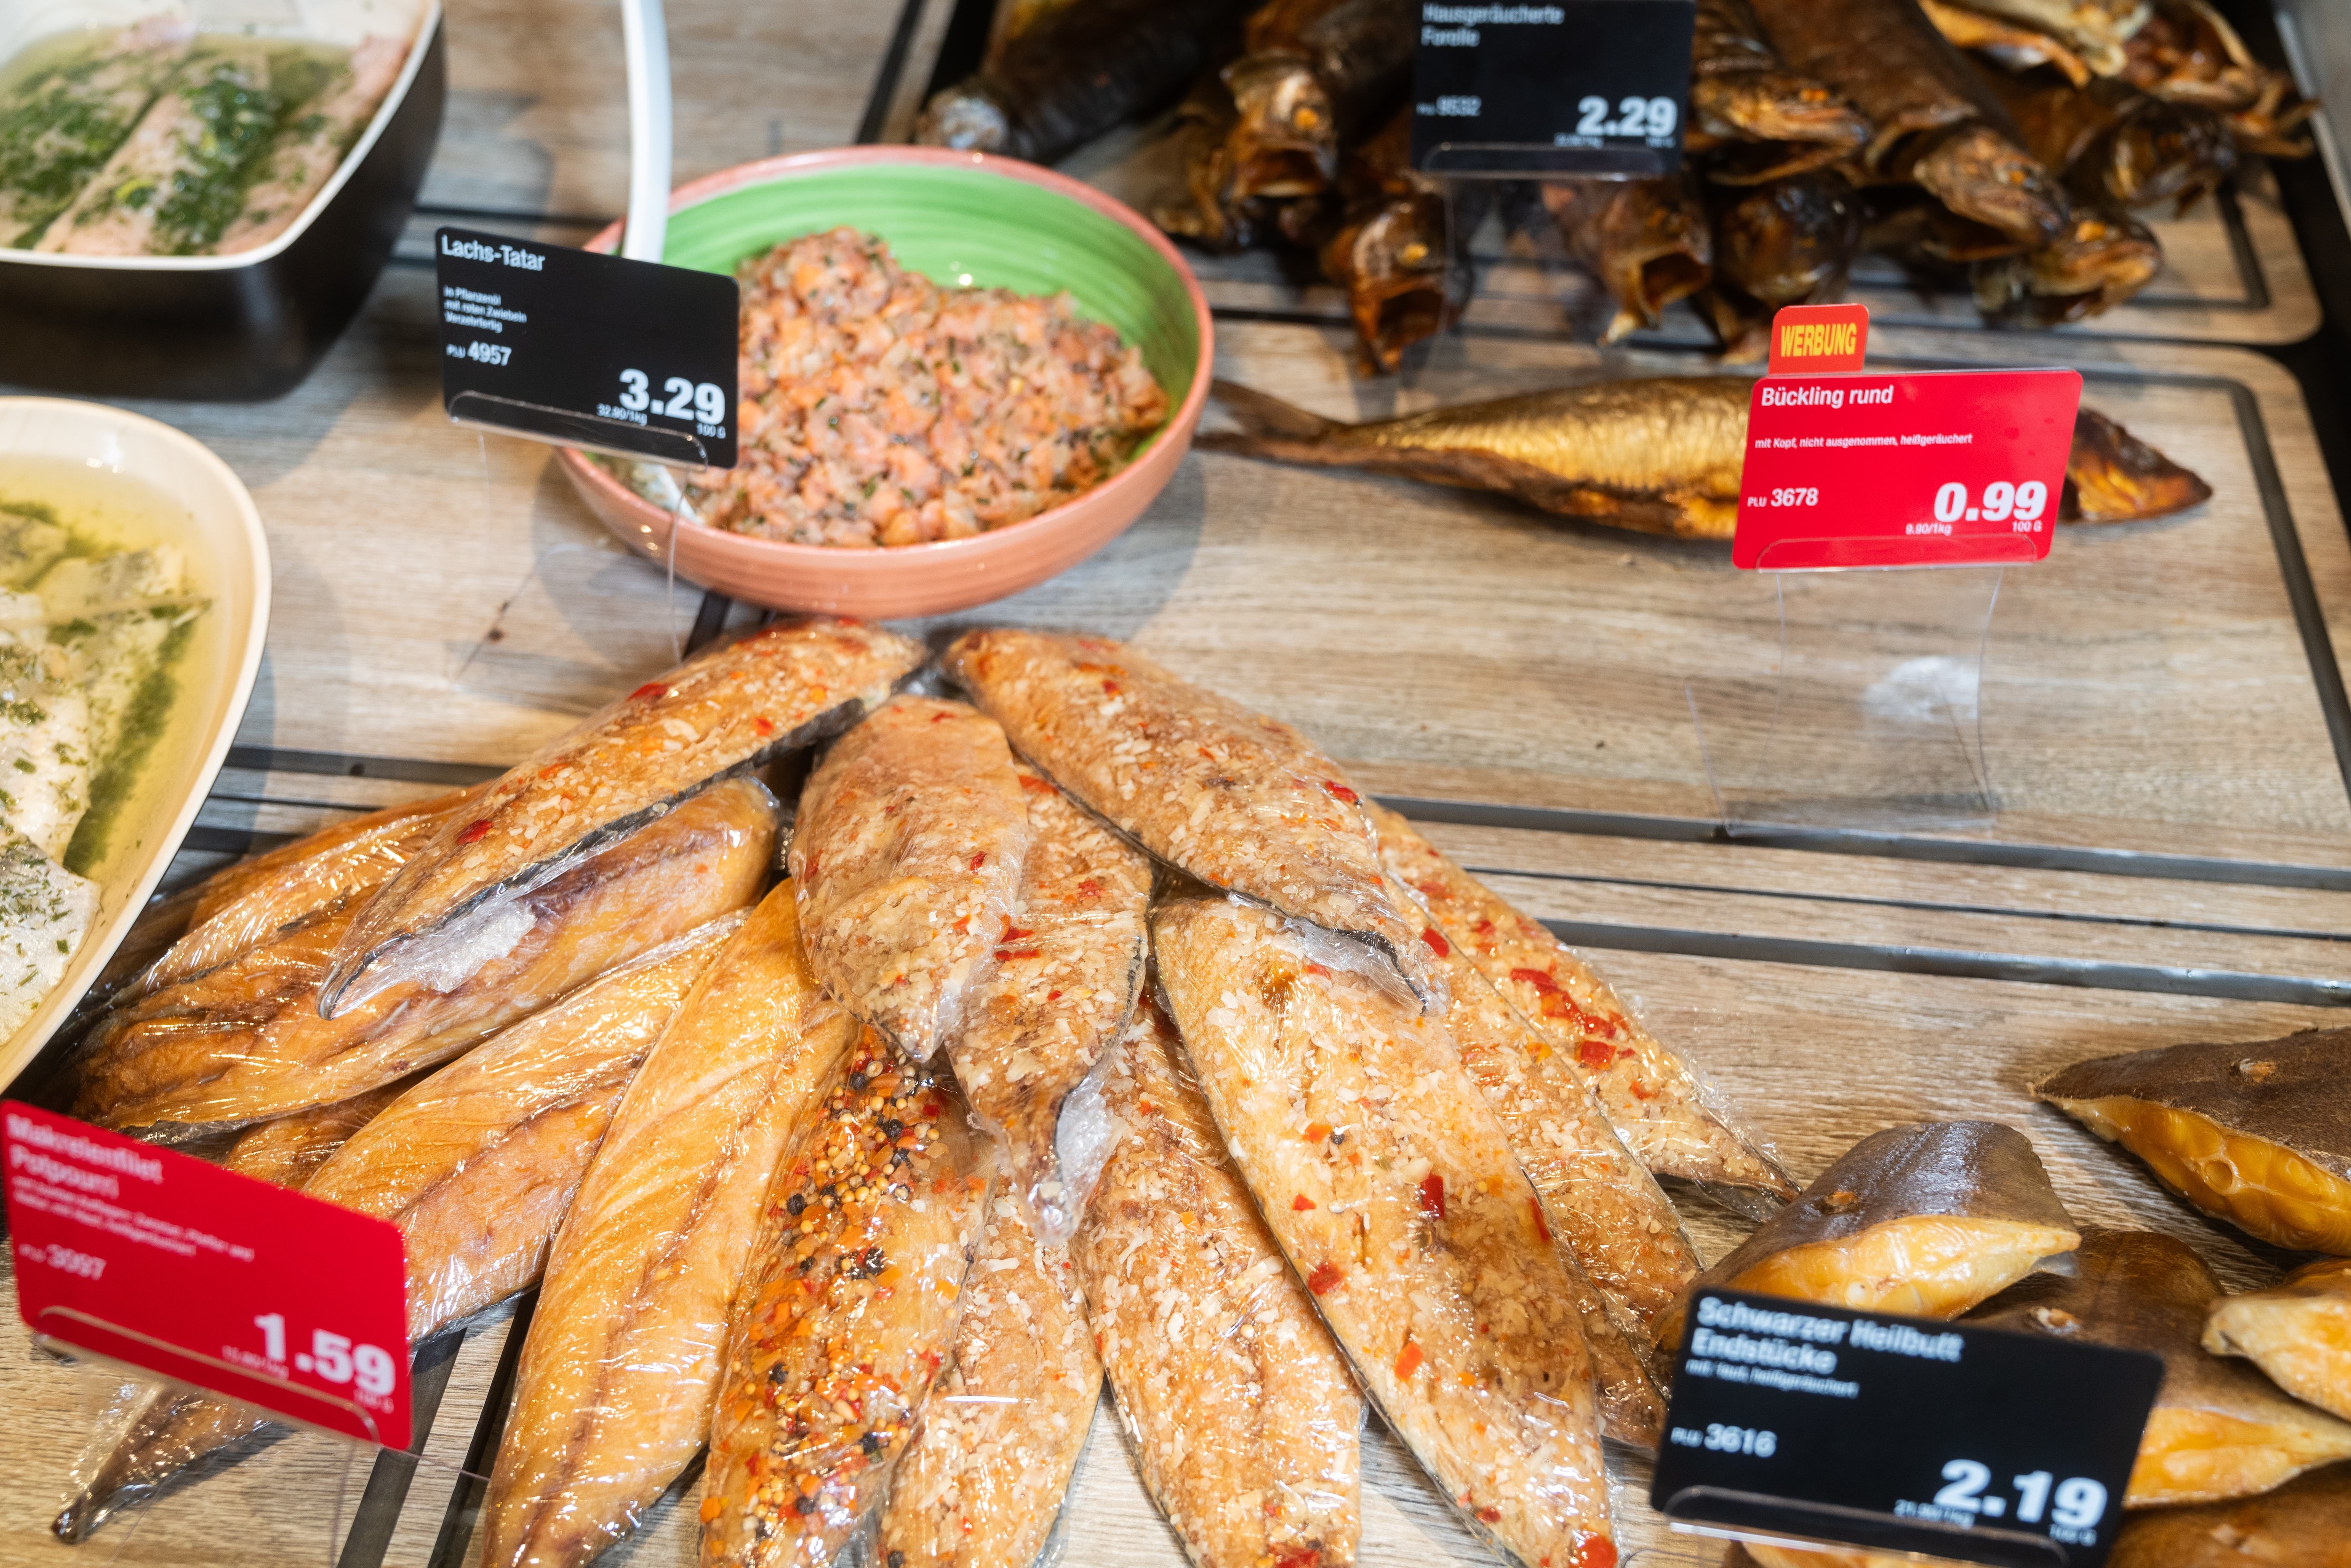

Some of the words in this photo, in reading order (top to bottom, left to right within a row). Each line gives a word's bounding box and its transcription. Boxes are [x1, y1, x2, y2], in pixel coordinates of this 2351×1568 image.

[1422, 2, 1565, 27] Hausgeräucherte
[1421, 24, 1480, 47] Forelle
[1576, 95, 1678, 136] 2.29
[442, 235, 545, 271] Lachs-Tatar
[454, 286, 501, 306] Pflanzenöl
[444, 299, 460, 311] mit
[461, 302, 485, 315] roten
[485, 305, 527, 323] Zwiebeln
[444, 310, 503, 333] Verzehrfertig
[1781, 323, 1857, 357] WERBUNG
[446, 344, 465, 358] PLU
[467, 340, 512, 366] 4957
[619, 368, 725, 425] 3.29
[1761, 387, 1844, 409] Bückling
[1849, 385, 1893, 404] rund
[597, 403, 647, 426] 32.90/1kg
[696, 423, 716, 437] 100
[716, 425, 726, 439] G
[1755, 438, 1771, 449] mit
[1773, 437, 1798, 449] Kopf,
[1799, 437, 1823, 448] nicht
[1825, 436, 1898, 449] ausgenommen,
[1900, 433, 1973, 447] heißgeräuchert
[1747, 497, 1767, 507] PLU
[1770, 487, 1819, 507] 3678
[1934, 481, 2047, 522] 0.99
[1905, 523, 1952, 536] 9.90/1kg
[2012, 521, 2032, 533] 100
[2033, 521, 2043, 532] G
[46, 1243, 107, 1281] 3097
[1696, 1296, 1851, 1345] Schwarzer
[1849, 1318, 1965, 1363] Heilbutt
[253, 1312, 396, 1396] 1.59
[1691, 1327, 1838, 1375] Endstücke
[1704, 1423, 1778, 1458] 3616
[1933, 1458, 2108, 1529] 2.19
